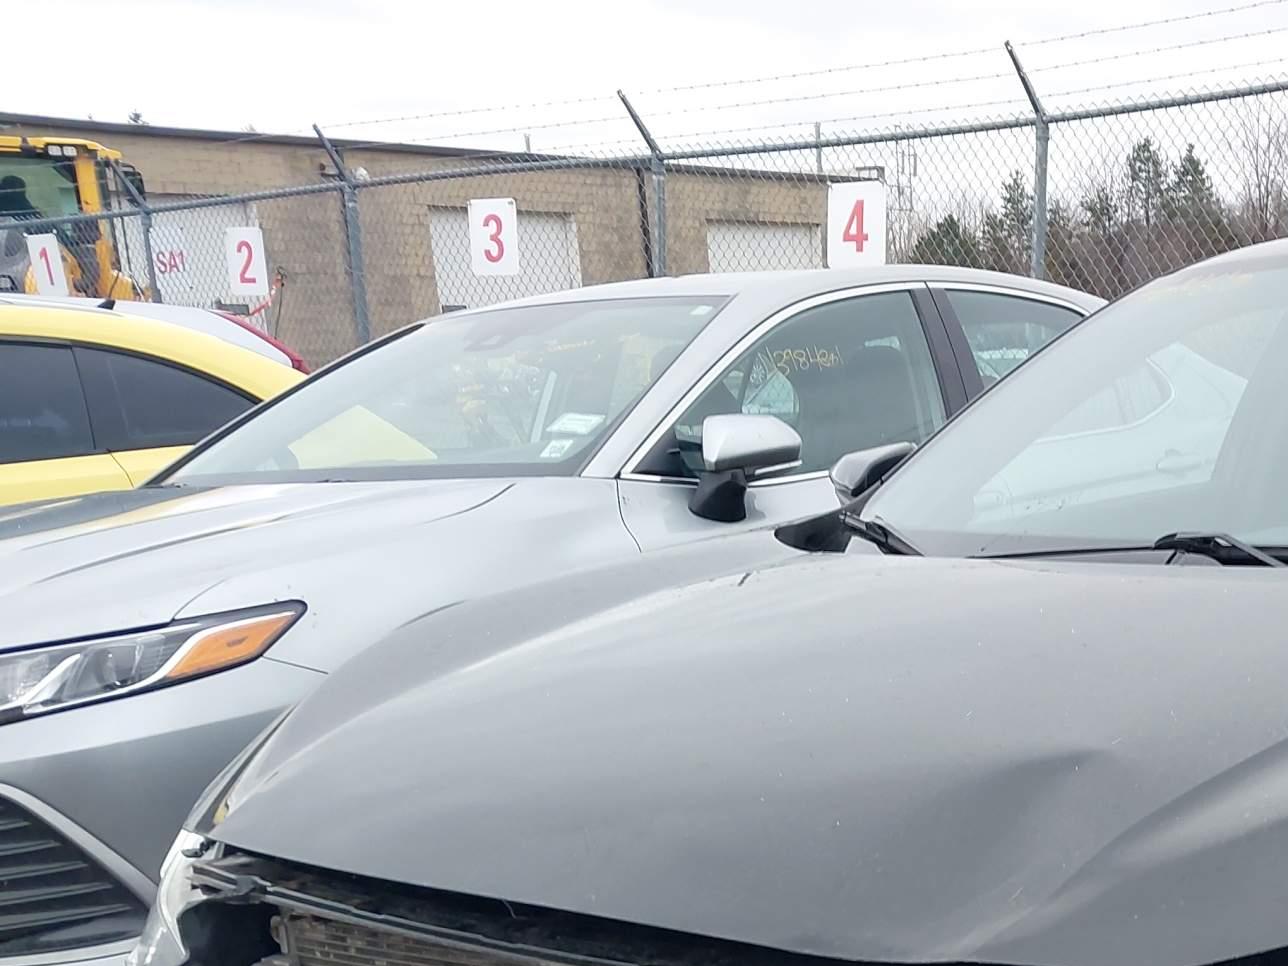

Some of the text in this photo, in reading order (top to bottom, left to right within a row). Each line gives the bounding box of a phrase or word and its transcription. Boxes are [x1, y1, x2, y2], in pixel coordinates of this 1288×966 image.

[483, 213, 504, 263] 3
[842, 199, 869, 252] 4
[39, 247, 55, 286] 1
[156, 249, 186, 275] SA1
[236, 240, 256, 284] 2
